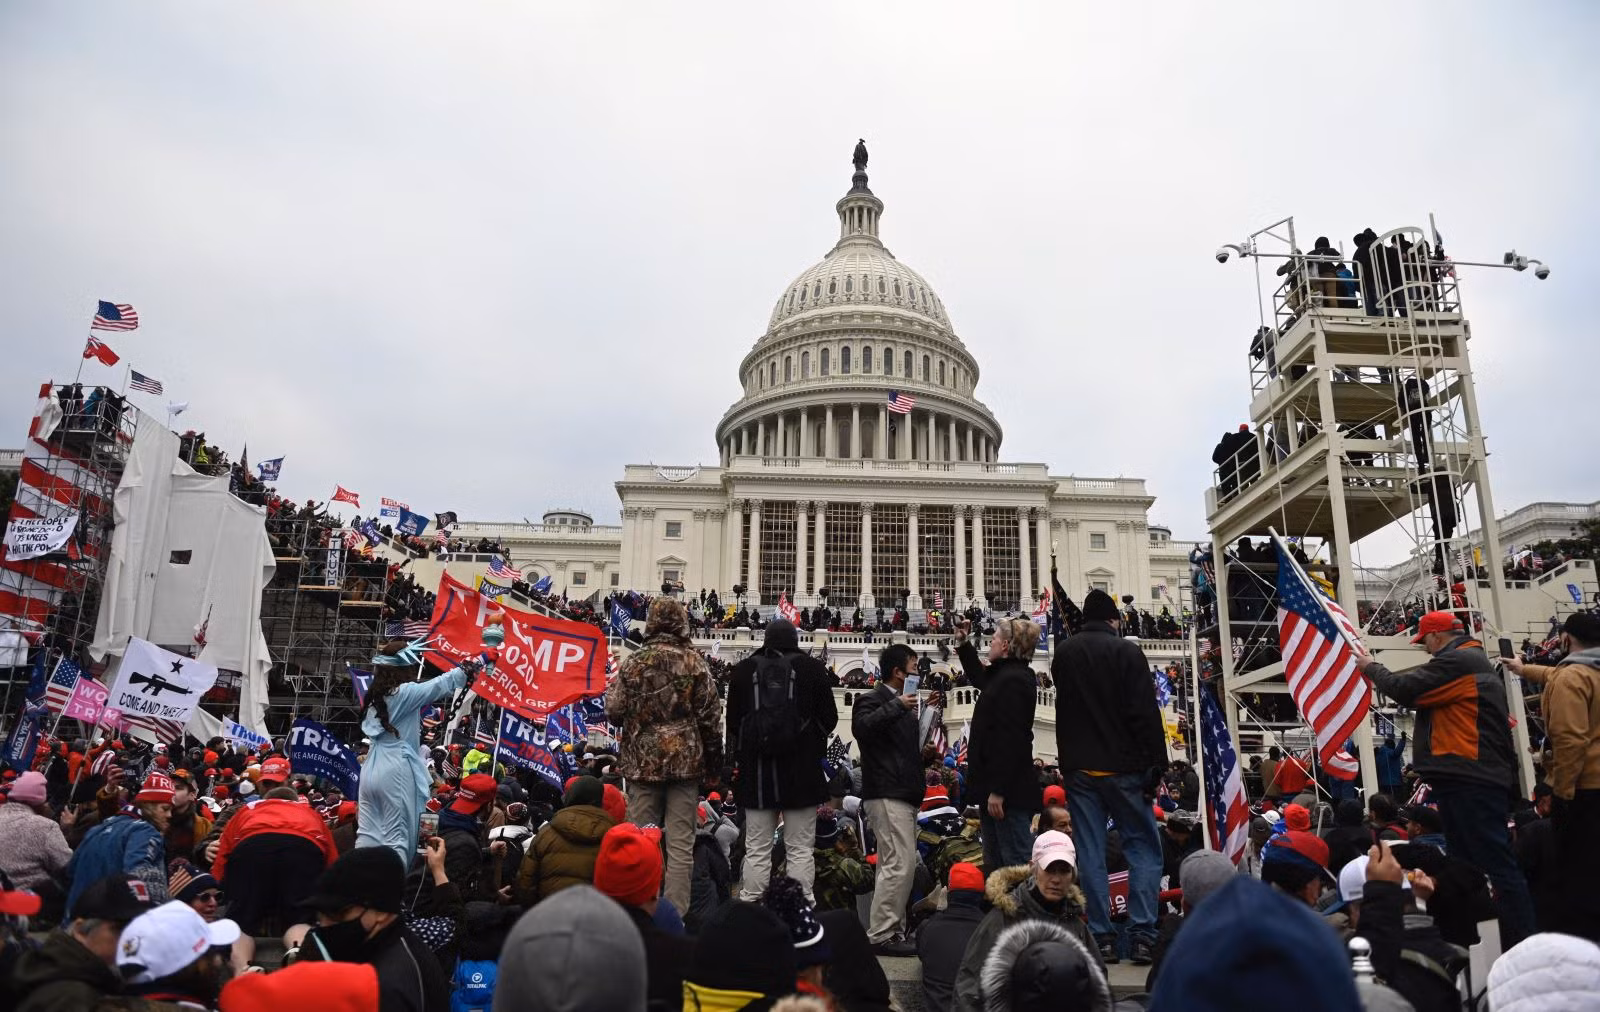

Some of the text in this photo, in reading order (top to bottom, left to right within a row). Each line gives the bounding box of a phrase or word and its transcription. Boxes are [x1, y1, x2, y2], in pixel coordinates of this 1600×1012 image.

[327, 540, 339, 586] TRUMP
[80, 685, 108, 702] WO
[489, 666, 522, 701] ERICA
[525, 698, 558, 709] GRE
[119, 692, 140, 710] COME
[139, 700, 161, 715] AND
[505, 712, 546, 746] TRU
[291, 726, 345, 759] TRU
[499, 746, 511, 756] NO
[518, 742, 553, 766] 2020
[301, 751, 333, 767] AMERICA
[333, 761, 350, 775] GREAT
[151, 775, 175, 791] TRU
